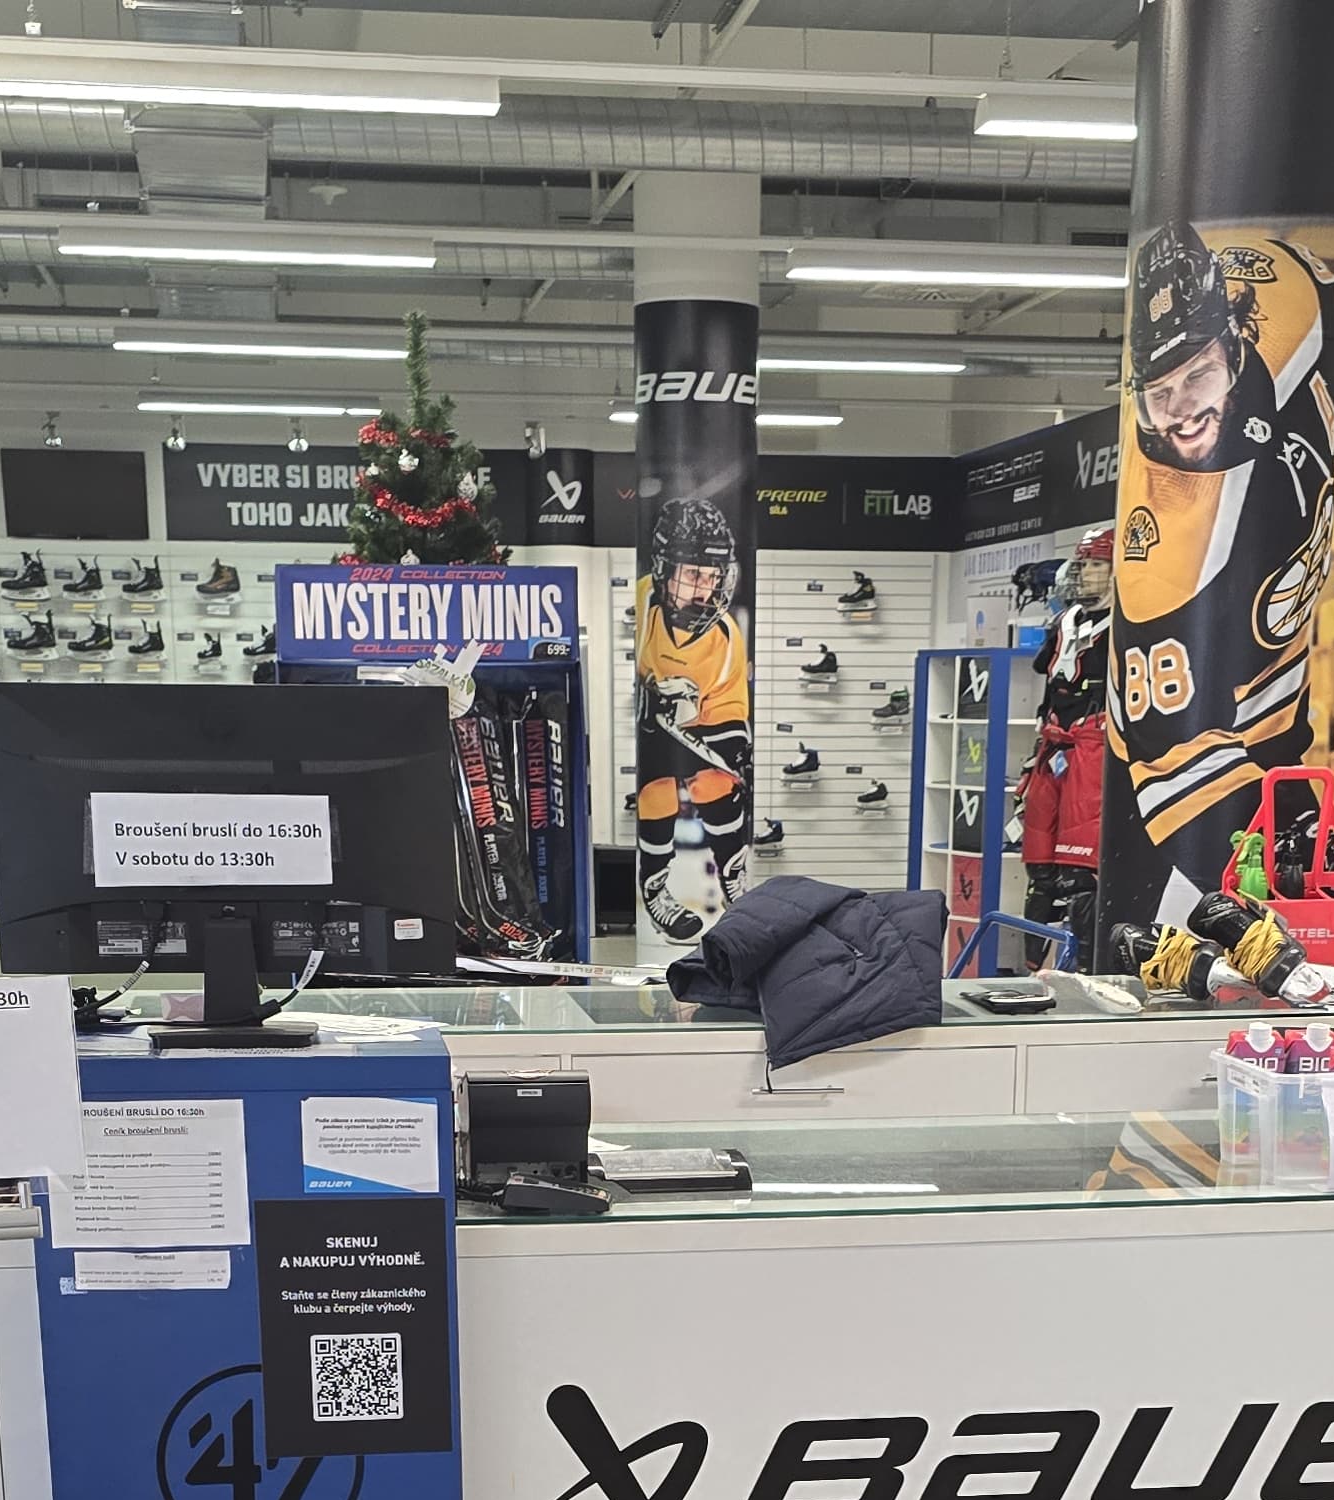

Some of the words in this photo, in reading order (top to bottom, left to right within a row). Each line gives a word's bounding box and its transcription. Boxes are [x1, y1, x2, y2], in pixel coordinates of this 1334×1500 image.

[197, 463, 280, 489] VYBER
[286, 464, 310, 488] SI
[756, 489, 828, 502] PREME
[227, 502, 293, 527] TOHO
[300, 503, 350, 527] JAK
[350, 567, 393, 582] 2024
[400, 570, 507, 580] COLLECTION
[292, 583, 454, 640] MYSTERY
[461, 584, 563, 640] MINIS
[352, 643, 458, 654] COLLECTIN
[1124, 637, 1194, 722] 88
[529, 782, 549, 831] MINIS
[114, 821, 188, 838] Broušení
[192, 822, 237, 838] bruslí
[242, 823, 263, 838] do
[268, 823, 323, 839] 16:30h
[115, 852, 127, 866] V
[132, 852, 189, 866] sobotu
[194, 852, 215, 866] do
[220, 852, 275, 867] 13:30h
[498, 921, 527, 944] 2024
[126, 1107, 159, 1117] BRUSLÍ
[309, 1181, 353, 1189] BAUER
[326, 1236, 378, 1249] SKENUJ
[279, 1256, 290, 1269] A
[293, 1255, 355, 1268] NAKUPUJ
[358, 1250, 425, 1267] VÝHODNĚ.
[281, 1289, 314, 1301] Staňte
[316, 1292, 329, 1301] se
[331, 1288, 358, 1302] členy
[360, 1287, 427, 1299] zákaznického
[293, 1303, 322, 1315] klubu
[324, 1306, 332, 1314] a
[333, 1301, 374, 1315] čerpejte
[376, 1300, 416, 1314] výhody.
